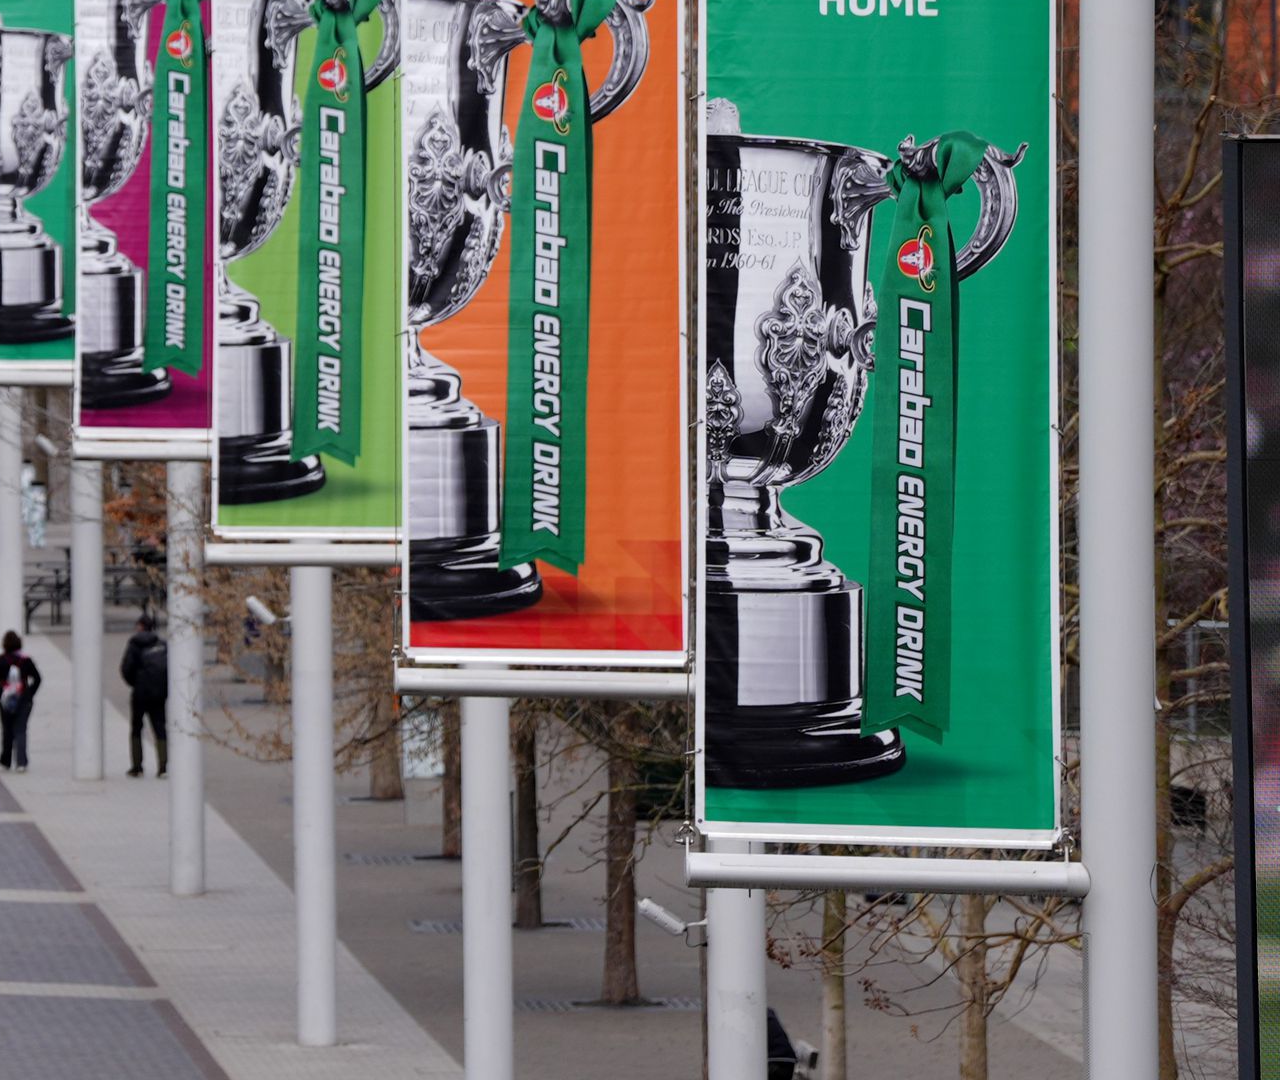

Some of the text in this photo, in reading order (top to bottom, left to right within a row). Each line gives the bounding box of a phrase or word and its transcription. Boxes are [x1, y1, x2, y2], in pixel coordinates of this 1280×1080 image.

[165, 72, 190, 349] Carabao ENERGY DRINK
[317, 106, 345, 433] Carabao ENERGY DRINK
[533, 139, 567, 536] Carabao ENERGY DRINK
[896, 298, 931, 702] Carabao ENERGY DRINK
